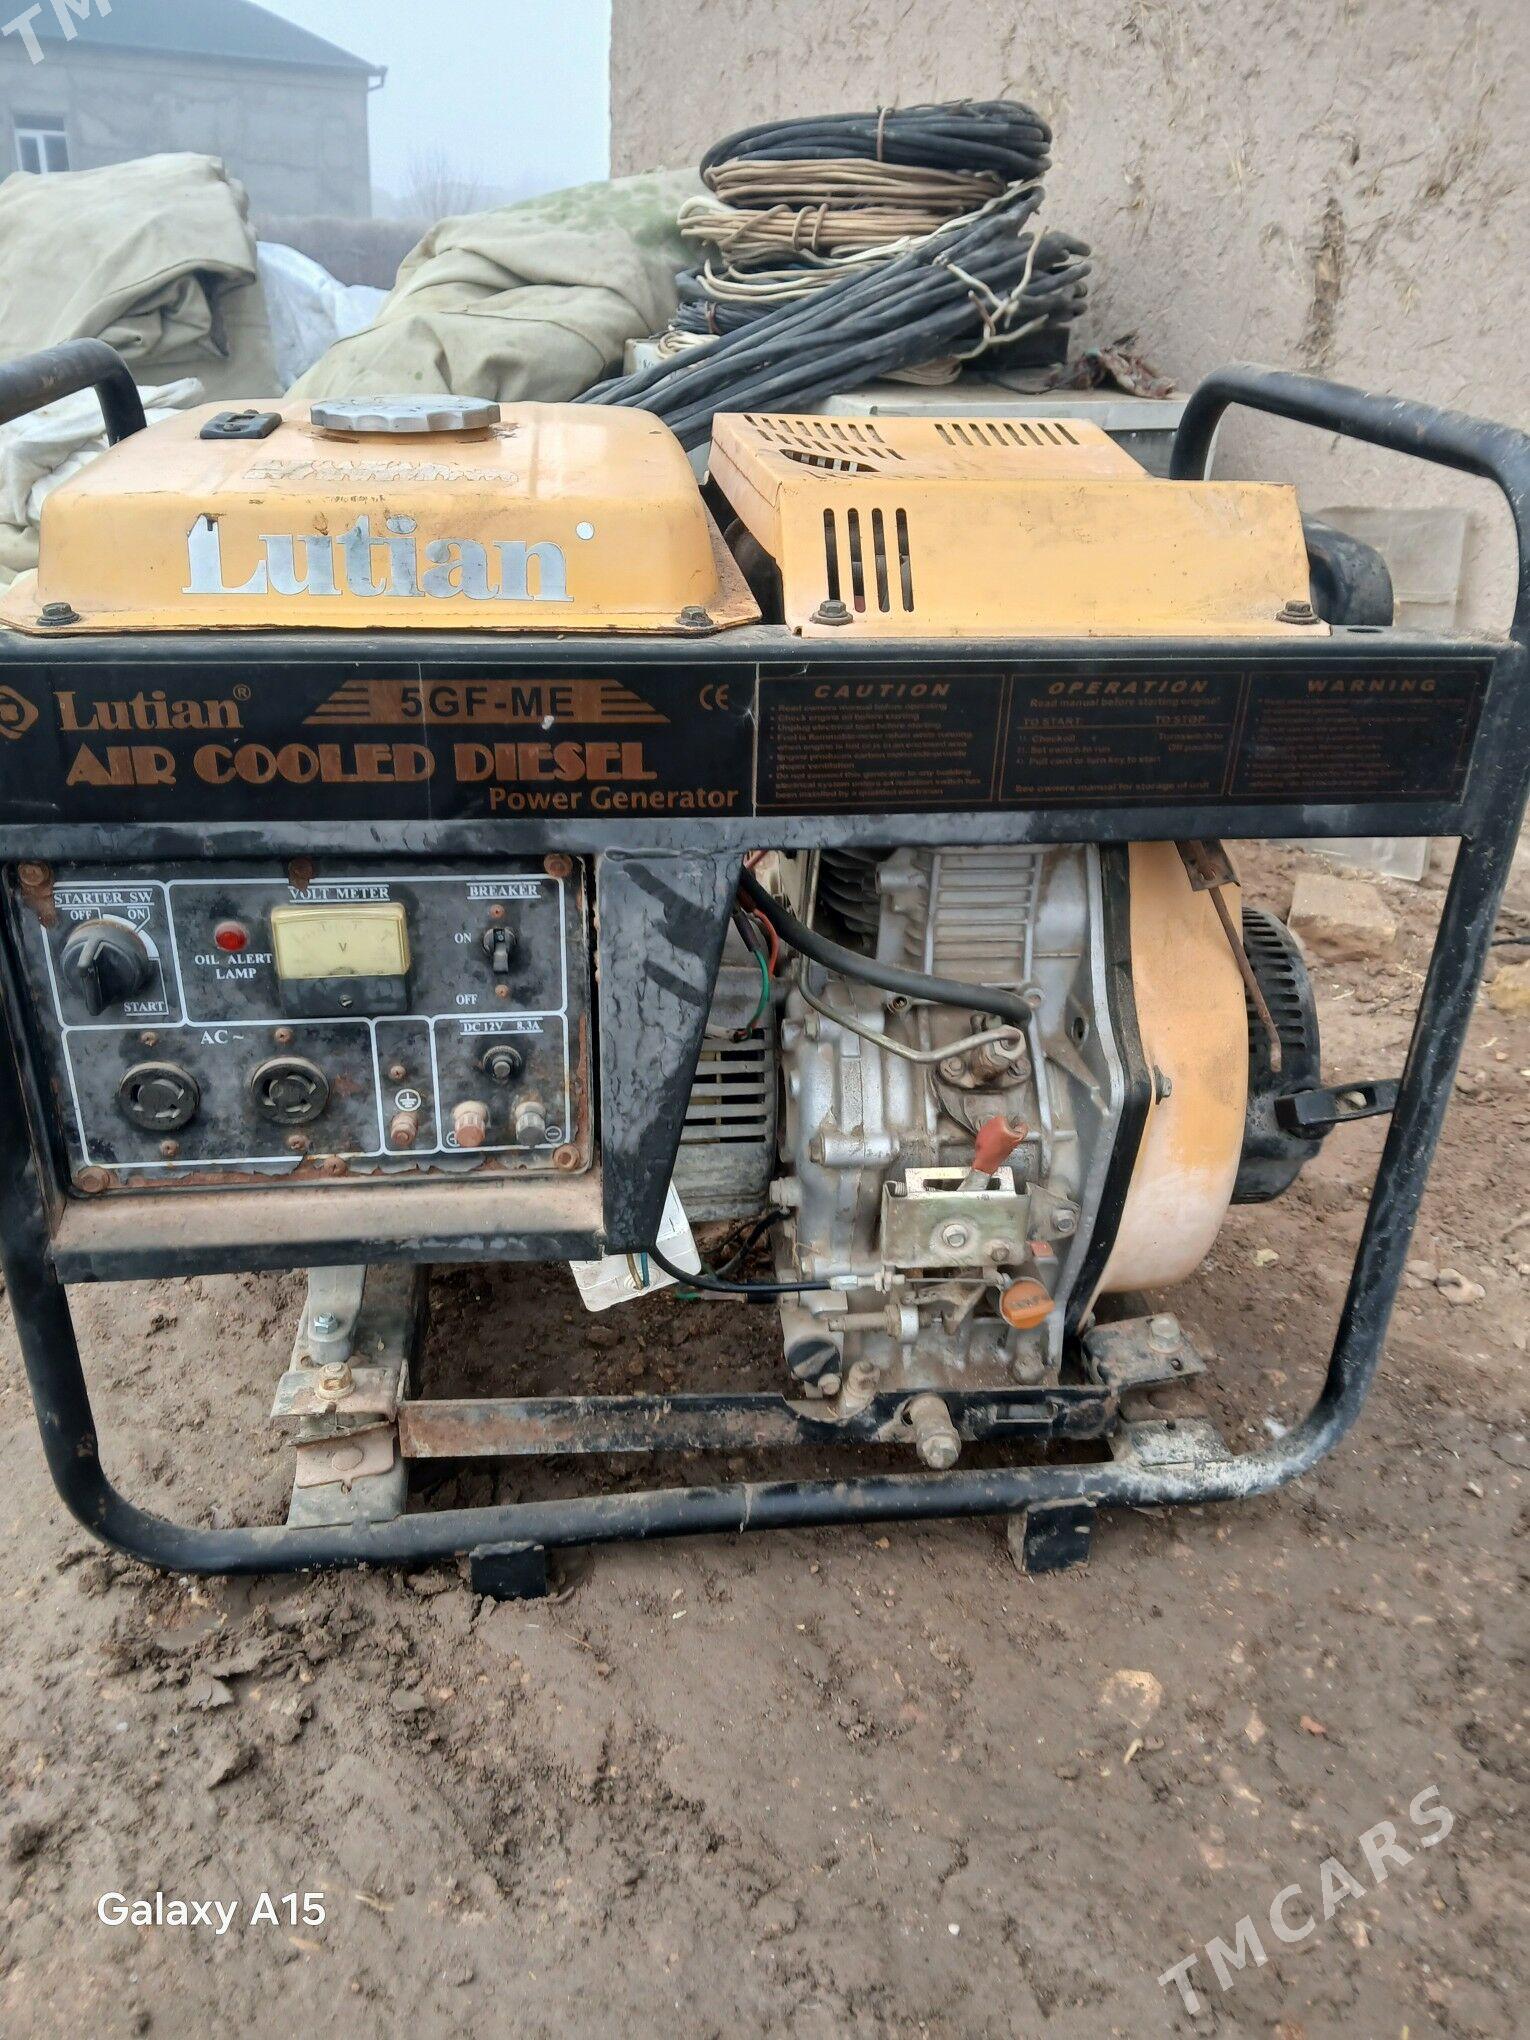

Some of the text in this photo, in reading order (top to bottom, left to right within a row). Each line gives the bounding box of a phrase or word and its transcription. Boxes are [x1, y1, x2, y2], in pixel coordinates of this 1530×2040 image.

[182, 514, 575, 602] Lutian
[814, 683, 950, 698] CAUTION
[1047, 680, 1209, 695] OPERATION
[1307, 679, 1438, 693] WARNING
[400, 686, 574, 718] 5GF-ME
[66, 741, 658, 786] AIR COOLED DIESEL
[489, 786, 739, 811] Power Generator
[289, 887, 389, 900] VOLT METER
[469, 884, 538, 897] BREAKER
[53, 891, 153, 904] STARTER SW
[70, 909, 92, 920] OFF
[127, 909, 146, 919] ON
[454, 932, 472, 944] ON
[338, 941, 348, 952] V
[194, 953, 273, 966] OIL ALERT
[216, 967, 257, 980] LAMP
[455, 993, 478, 1006] OFF
[123, 1001, 165, 1012] START
